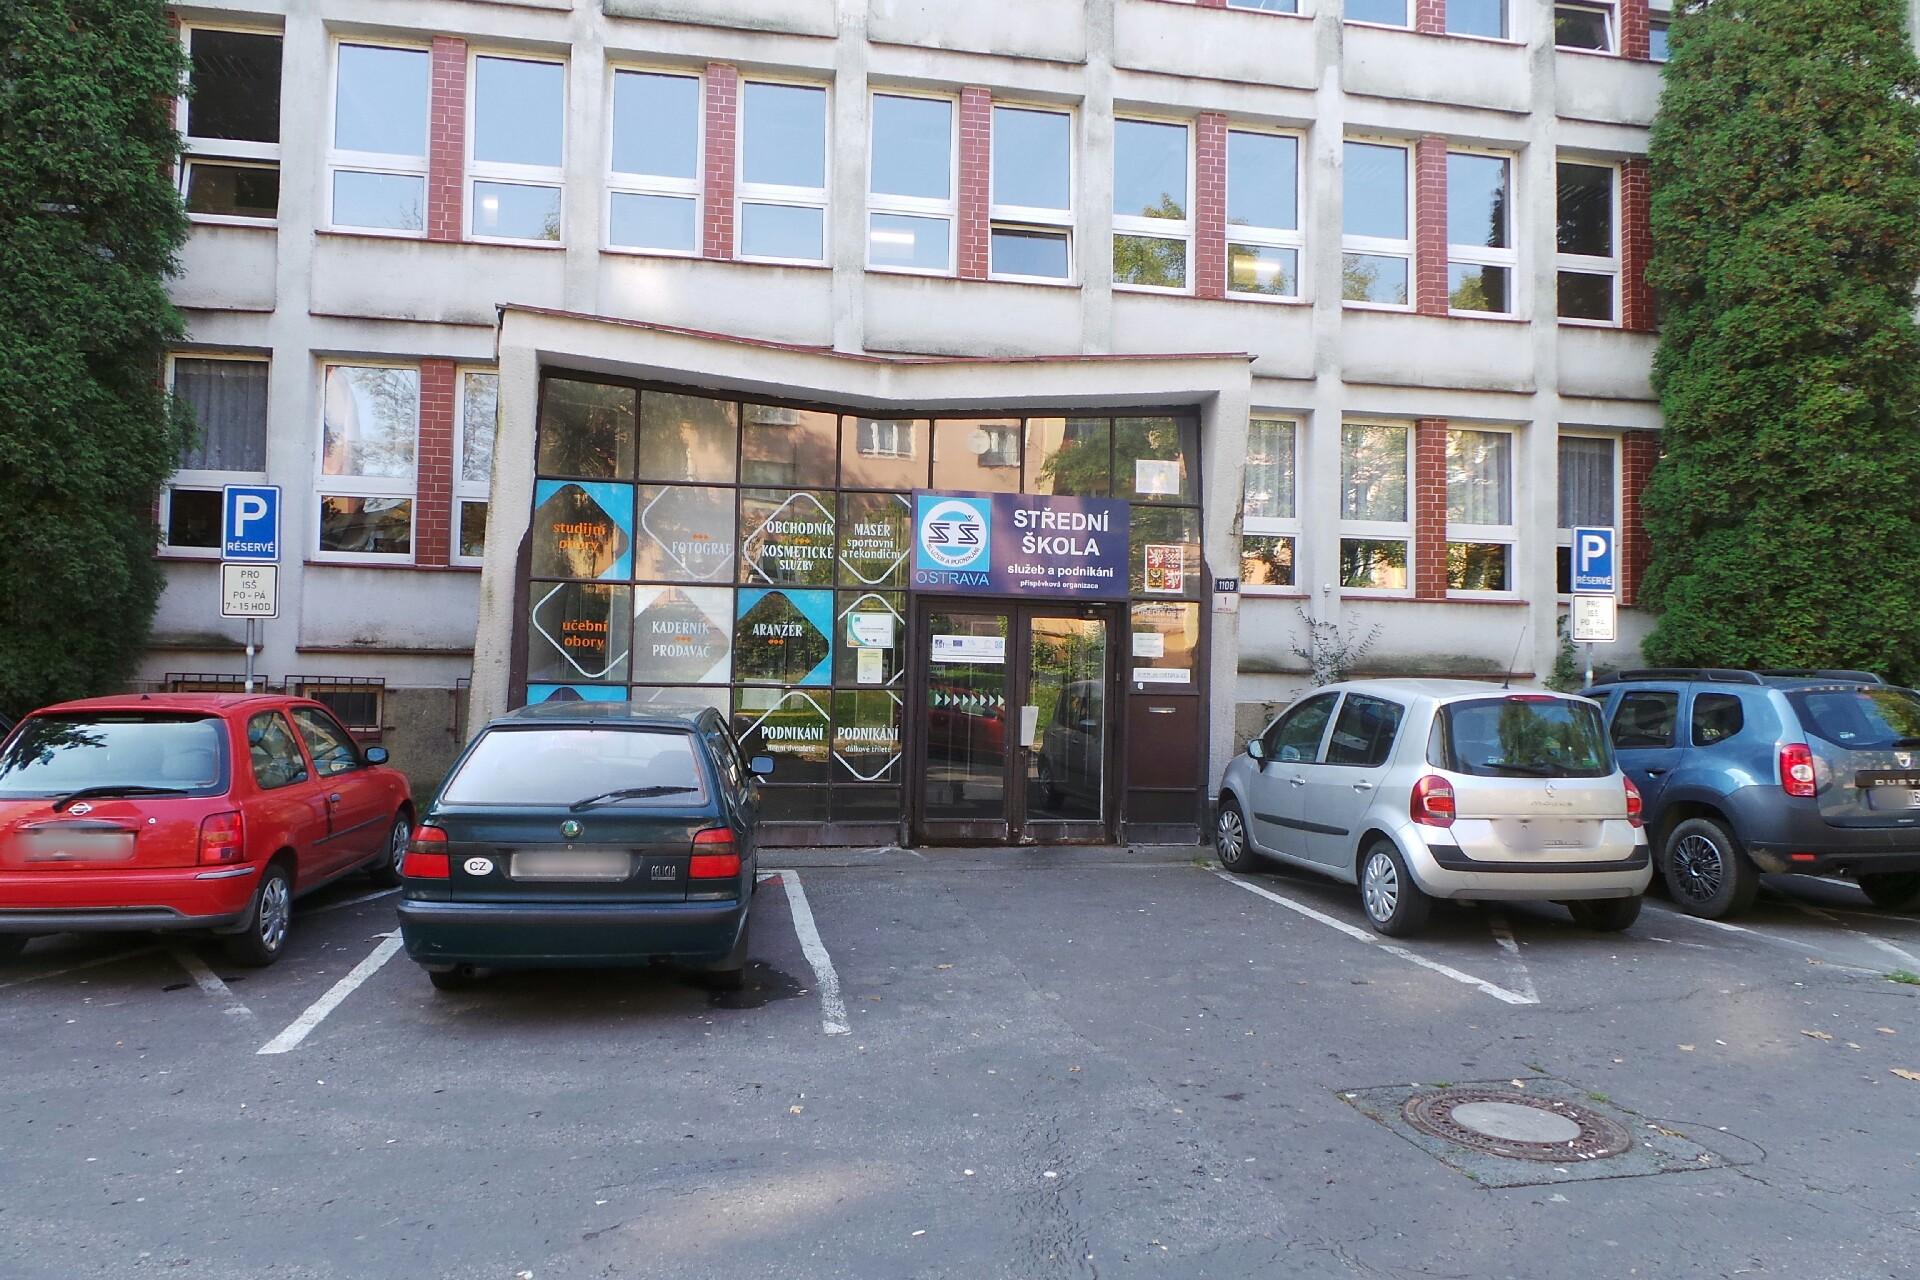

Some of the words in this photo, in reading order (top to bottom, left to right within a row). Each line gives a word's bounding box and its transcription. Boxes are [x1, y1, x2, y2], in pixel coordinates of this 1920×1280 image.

[235, 494, 268, 537] P
[1013, 507, 1110, 532] STŘEDNÍ
[766, 520, 835, 536] OBCHODNÍK
[854, 521, 891, 537] MASÉR
[227, 540, 274, 553] RÉSERVÉ
[672, 540, 732, 556] FOTOGRAF
[847, 537, 894, 549] sportovní
[1021, 531, 1101, 556] ŠKOLA
[762, 544, 834, 560] KOSMETICKÉ
[1581, 534, 1607, 572] P
[779, 560, 814, 572] SLUŽBY
[1007, 564, 1045, 576] služeb
[1047, 568, 1055, 576] a
[1057, 566, 1114, 578] podnikání
[241, 570, 260, 579] PRO
[915, 570, 990, 586] OSTRAVA
[233, 591, 246, 599] PO
[254, 591, 266, 600] PÁ
[225, 602, 231, 610] 7
[240, 602, 249, 610] 15
[562, 619, 609, 633] učební
[752, 621, 803, 637] ARANŽÉR
[564, 635, 605, 650] obory
[652, 642, 711, 657] PRODAVAČ
[761, 722, 824, 741] PODNIKÁNÍ
[837, 723, 899, 741] PODNIKÁNÍ
[845, 744, 870, 753] dálkové
[469, 860, 487, 873] CZ
